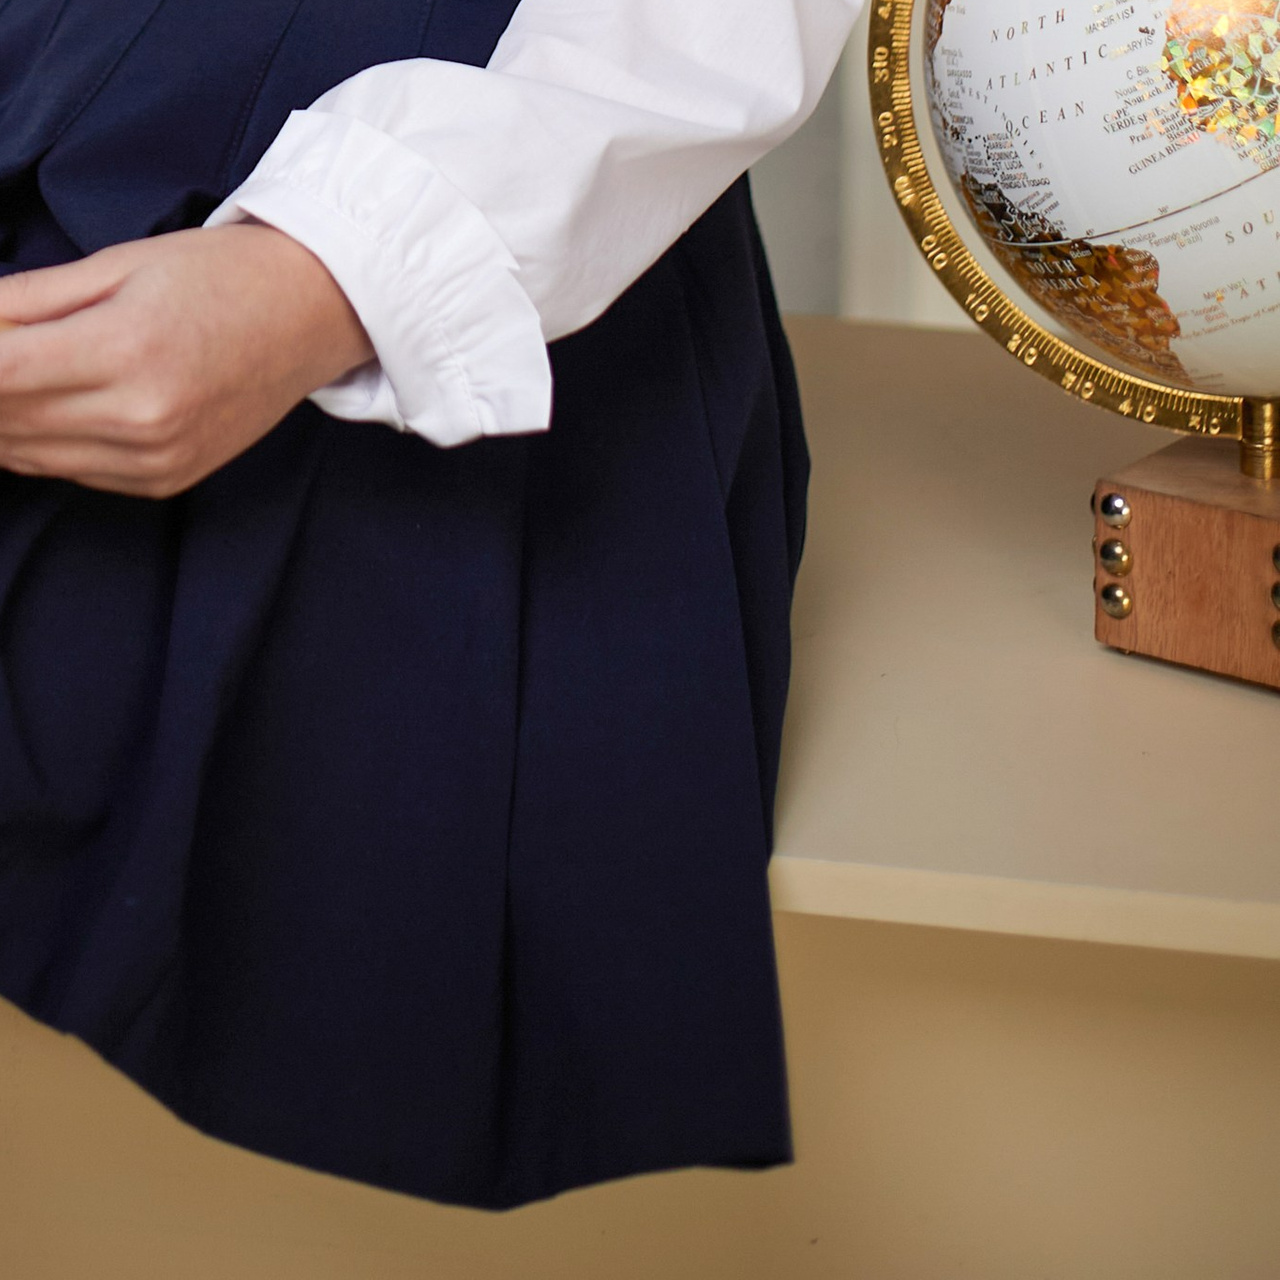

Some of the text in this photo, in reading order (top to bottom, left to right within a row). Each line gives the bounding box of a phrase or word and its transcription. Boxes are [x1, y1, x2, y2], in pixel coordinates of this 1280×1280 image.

[990, 7, 1066, 43] NORTH
[985, 43, 1108, 92] ATLANTIC
[1004, 100, 1086, 135] OCEAN
[1239, 270, 1280, 300] AT
